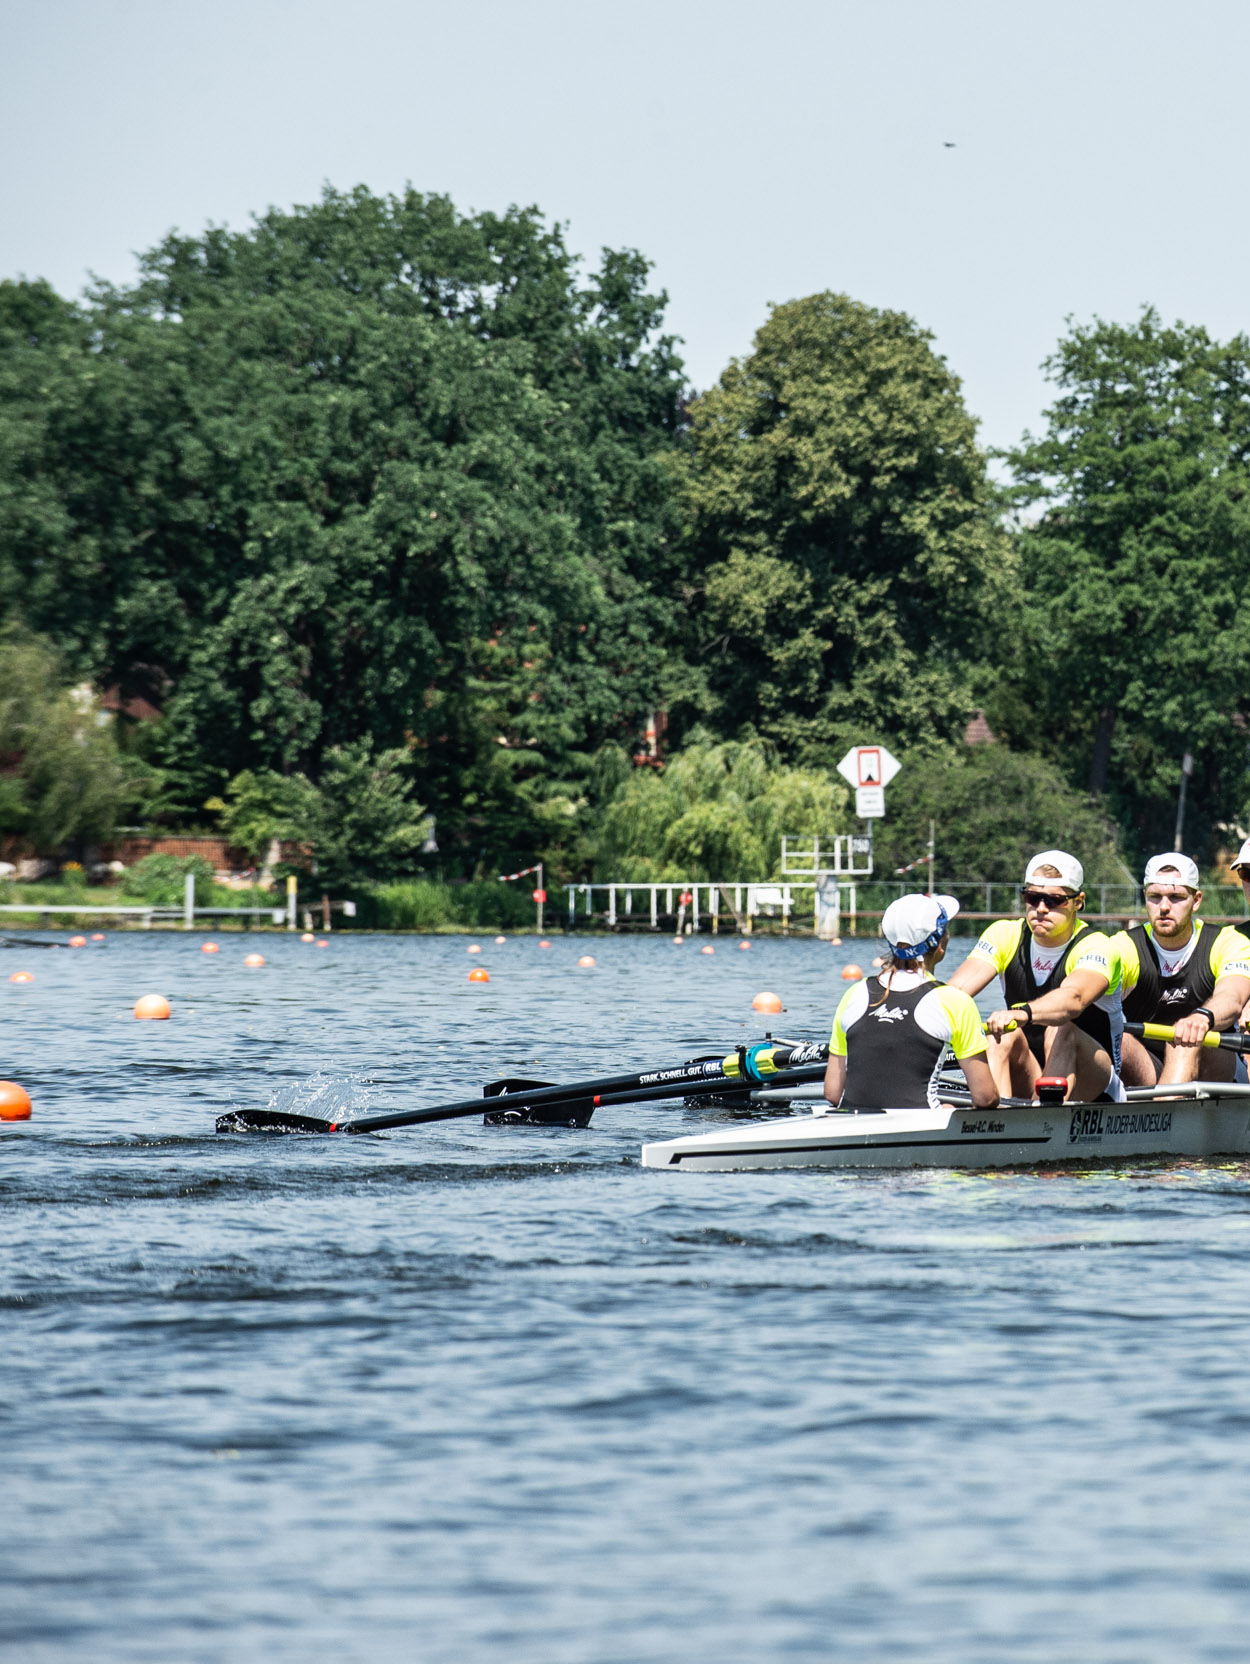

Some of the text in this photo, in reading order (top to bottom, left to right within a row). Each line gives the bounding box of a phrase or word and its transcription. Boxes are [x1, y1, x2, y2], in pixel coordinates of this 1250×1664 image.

[1086, 954, 1107, 967] RBL
[789, 1044, 826, 1063] Melitta
[639, 1072, 660, 1084] STARK.
[659, 1069, 688, 1081] SCHNELL.
[687, 1066, 702, 1076] GUT.
[705, 1062, 721, 1072] RBL
[1080, 1110, 1103, 1134] RBL
[1105, 1112, 1172, 1135] RUDER-BUNDESLIGA
